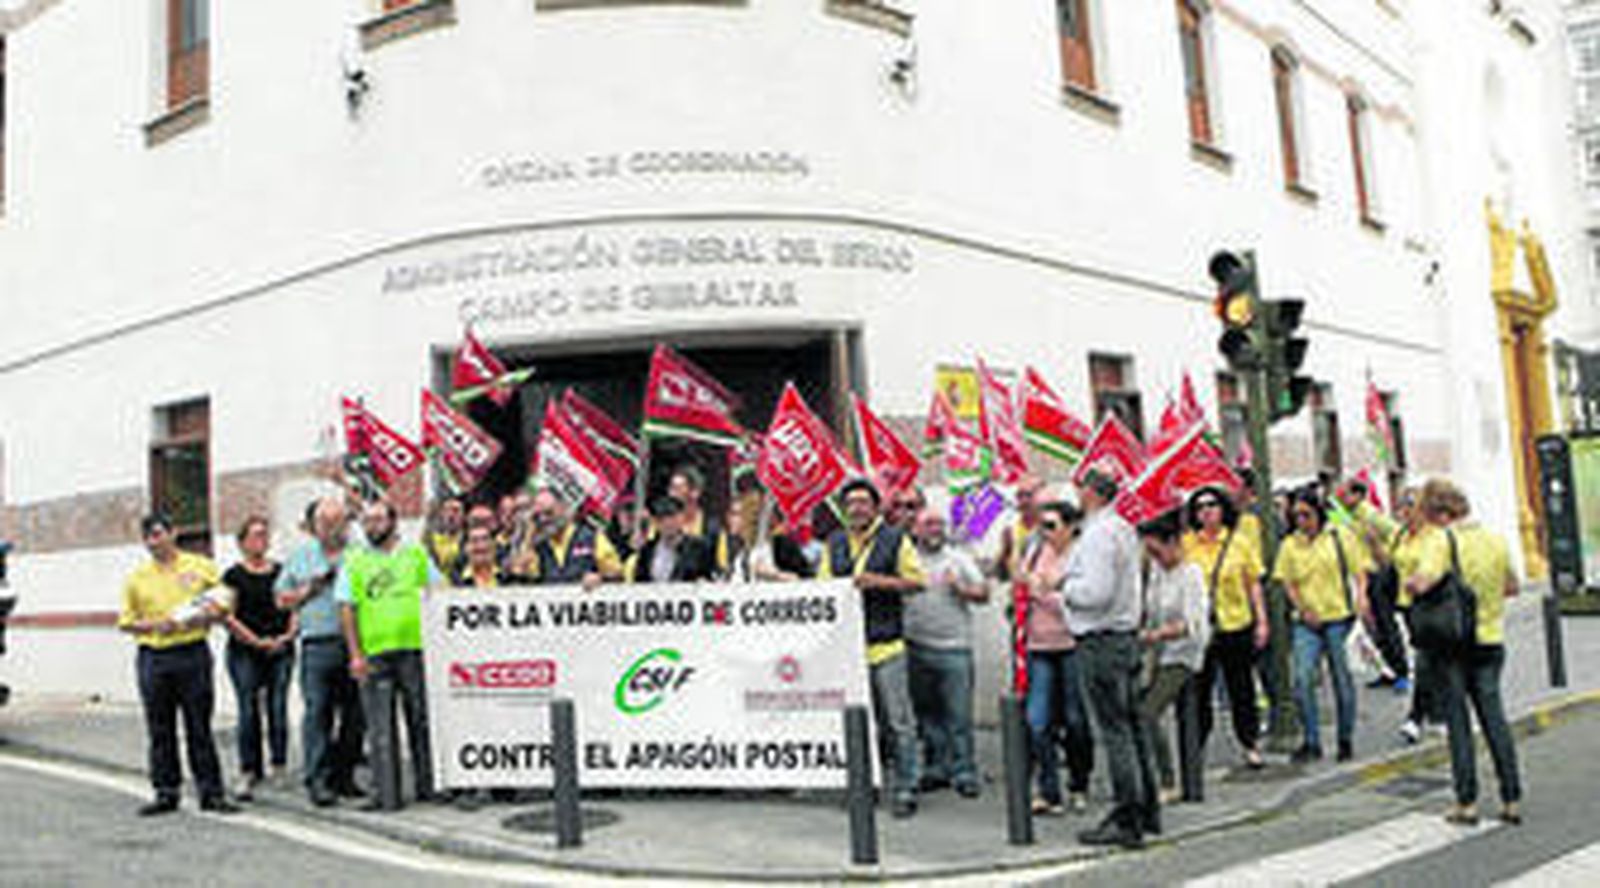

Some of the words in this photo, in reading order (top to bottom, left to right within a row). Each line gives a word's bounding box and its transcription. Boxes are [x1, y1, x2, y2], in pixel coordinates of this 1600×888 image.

[579, 285, 622, 313] DE
[446, 604, 502, 631] POR
[508, 603, 542, 629] LA
[548, 600, 696, 628] VIABILIDAD
[702, 599, 733, 626] DE
[739, 597, 838, 626] CORREOS
[584, 743, 618, 771] EL
[624, 736, 739, 771] APAGÓN
[744, 742, 847, 771] POSTAL
